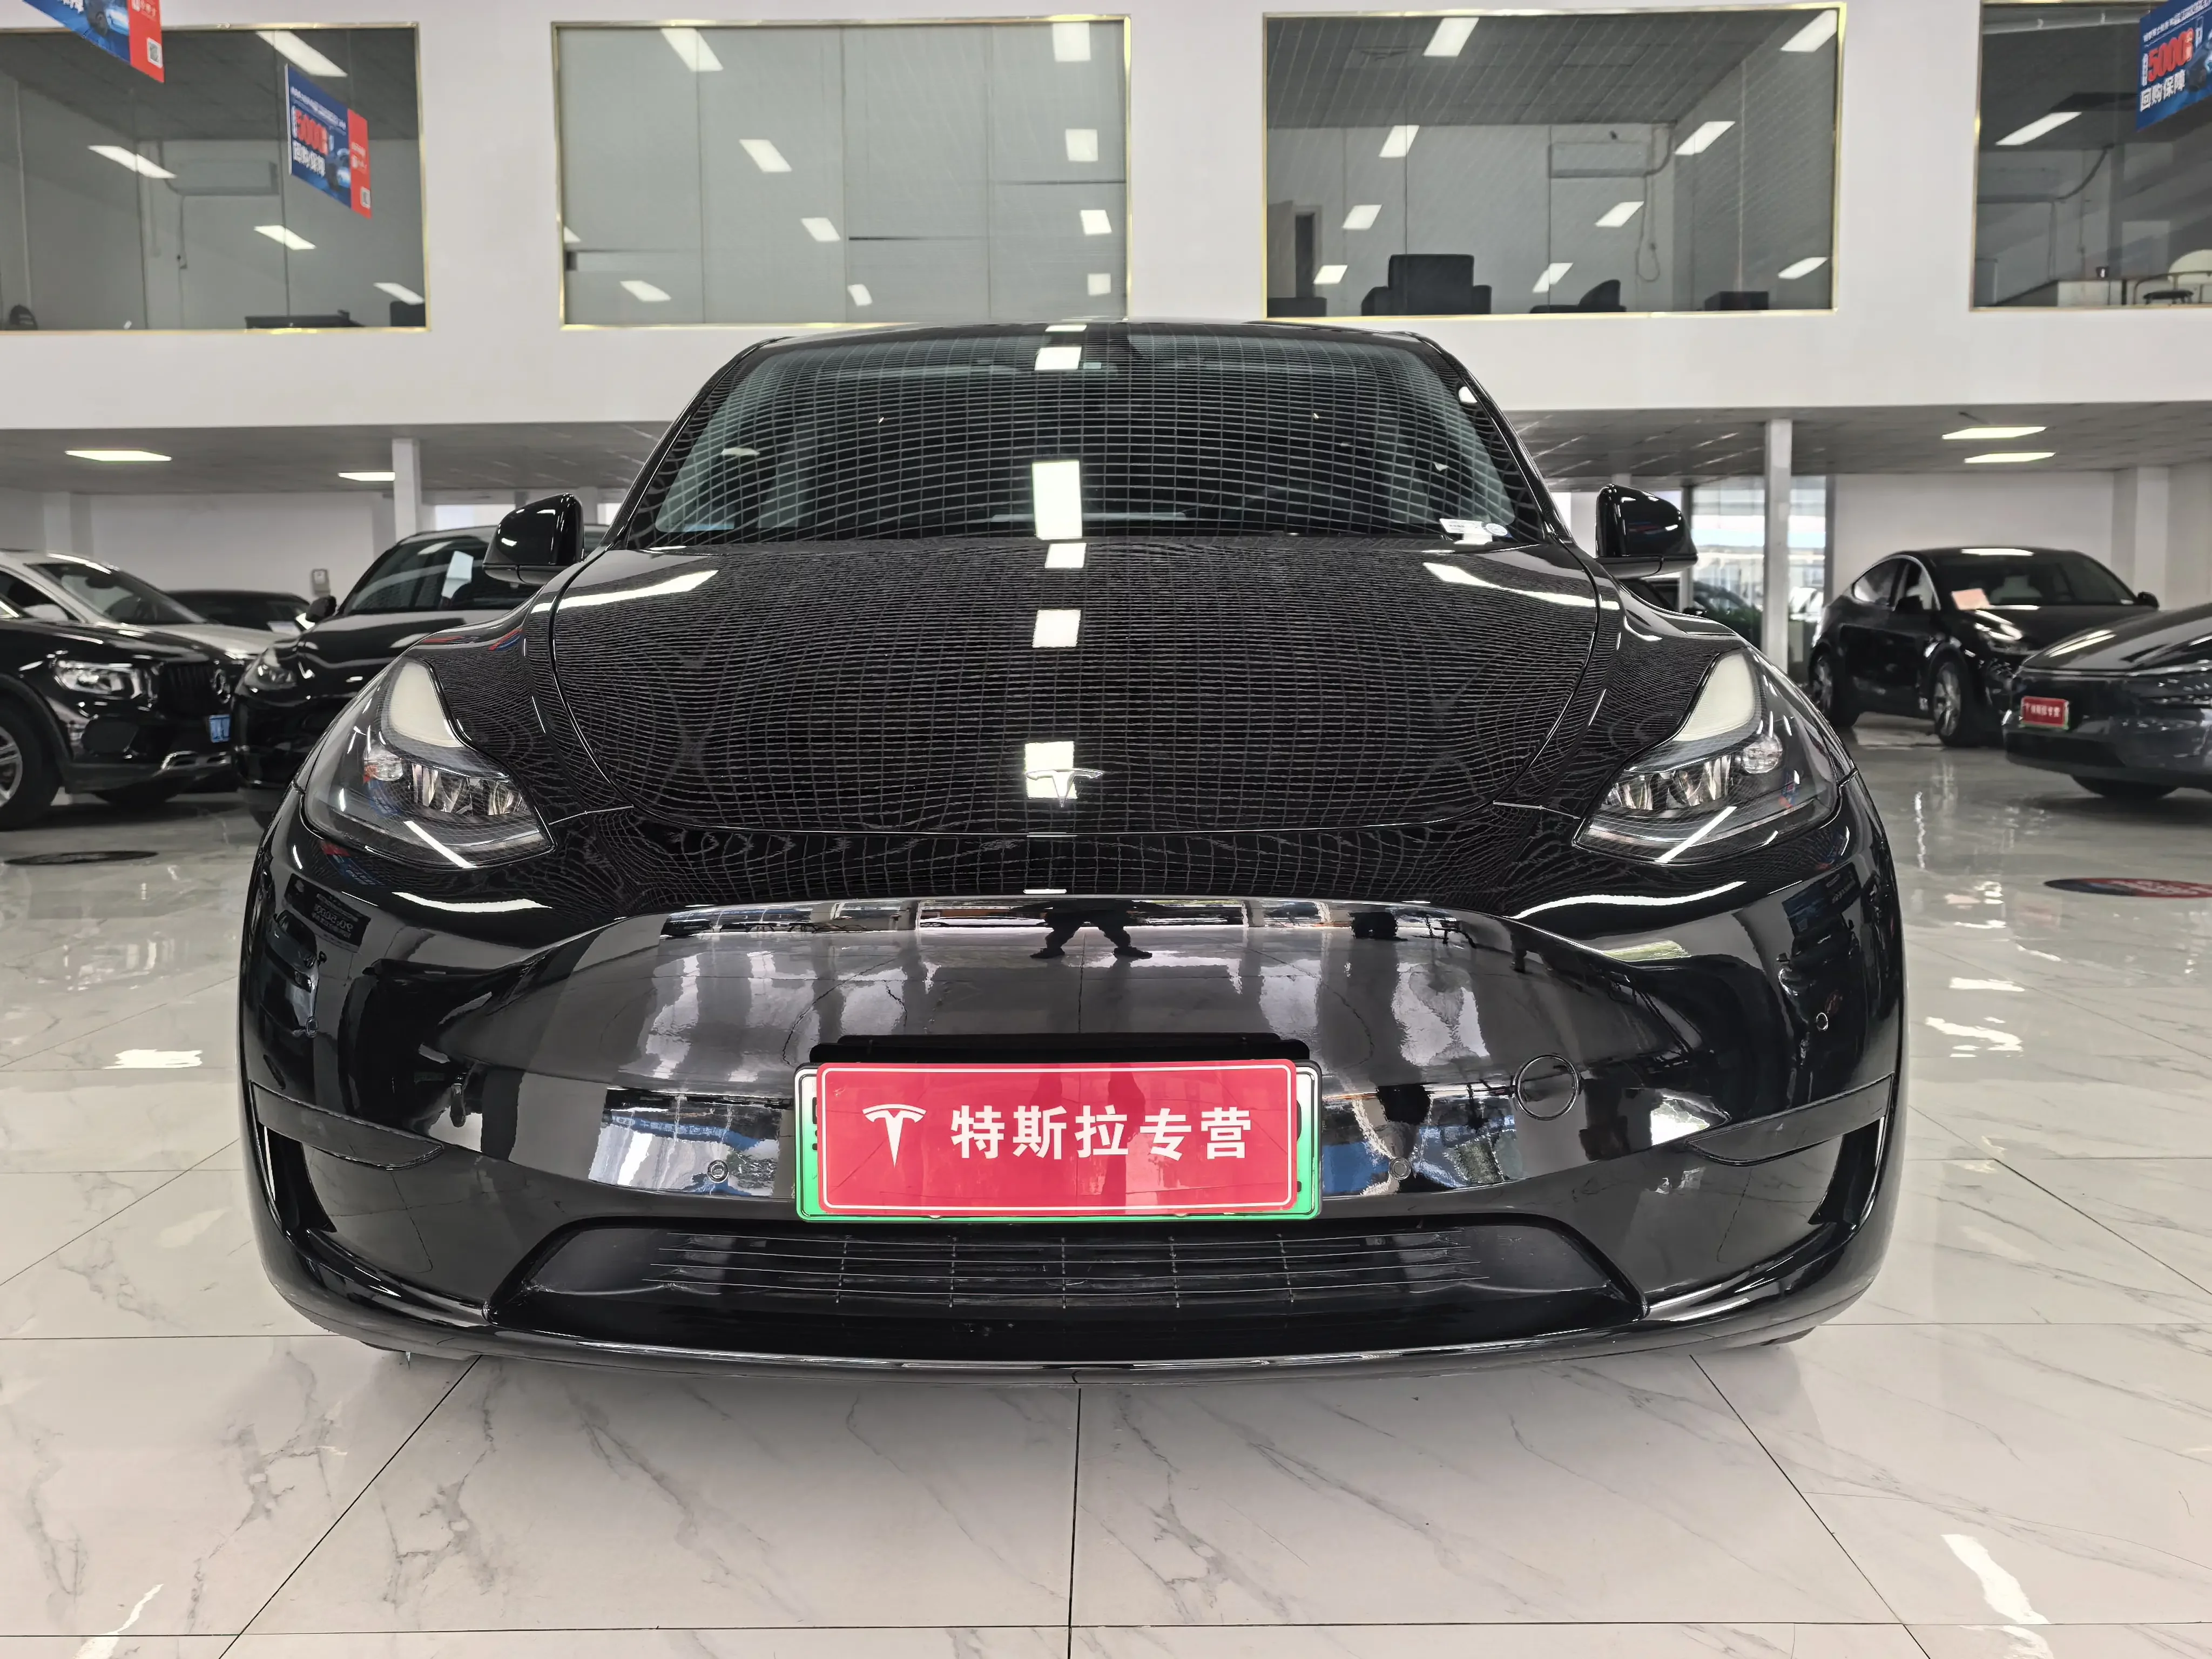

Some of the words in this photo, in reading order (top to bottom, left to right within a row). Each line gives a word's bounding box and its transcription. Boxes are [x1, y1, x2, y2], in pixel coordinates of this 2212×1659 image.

[950, 1104, 1251, 1161] 特斯拉专营
